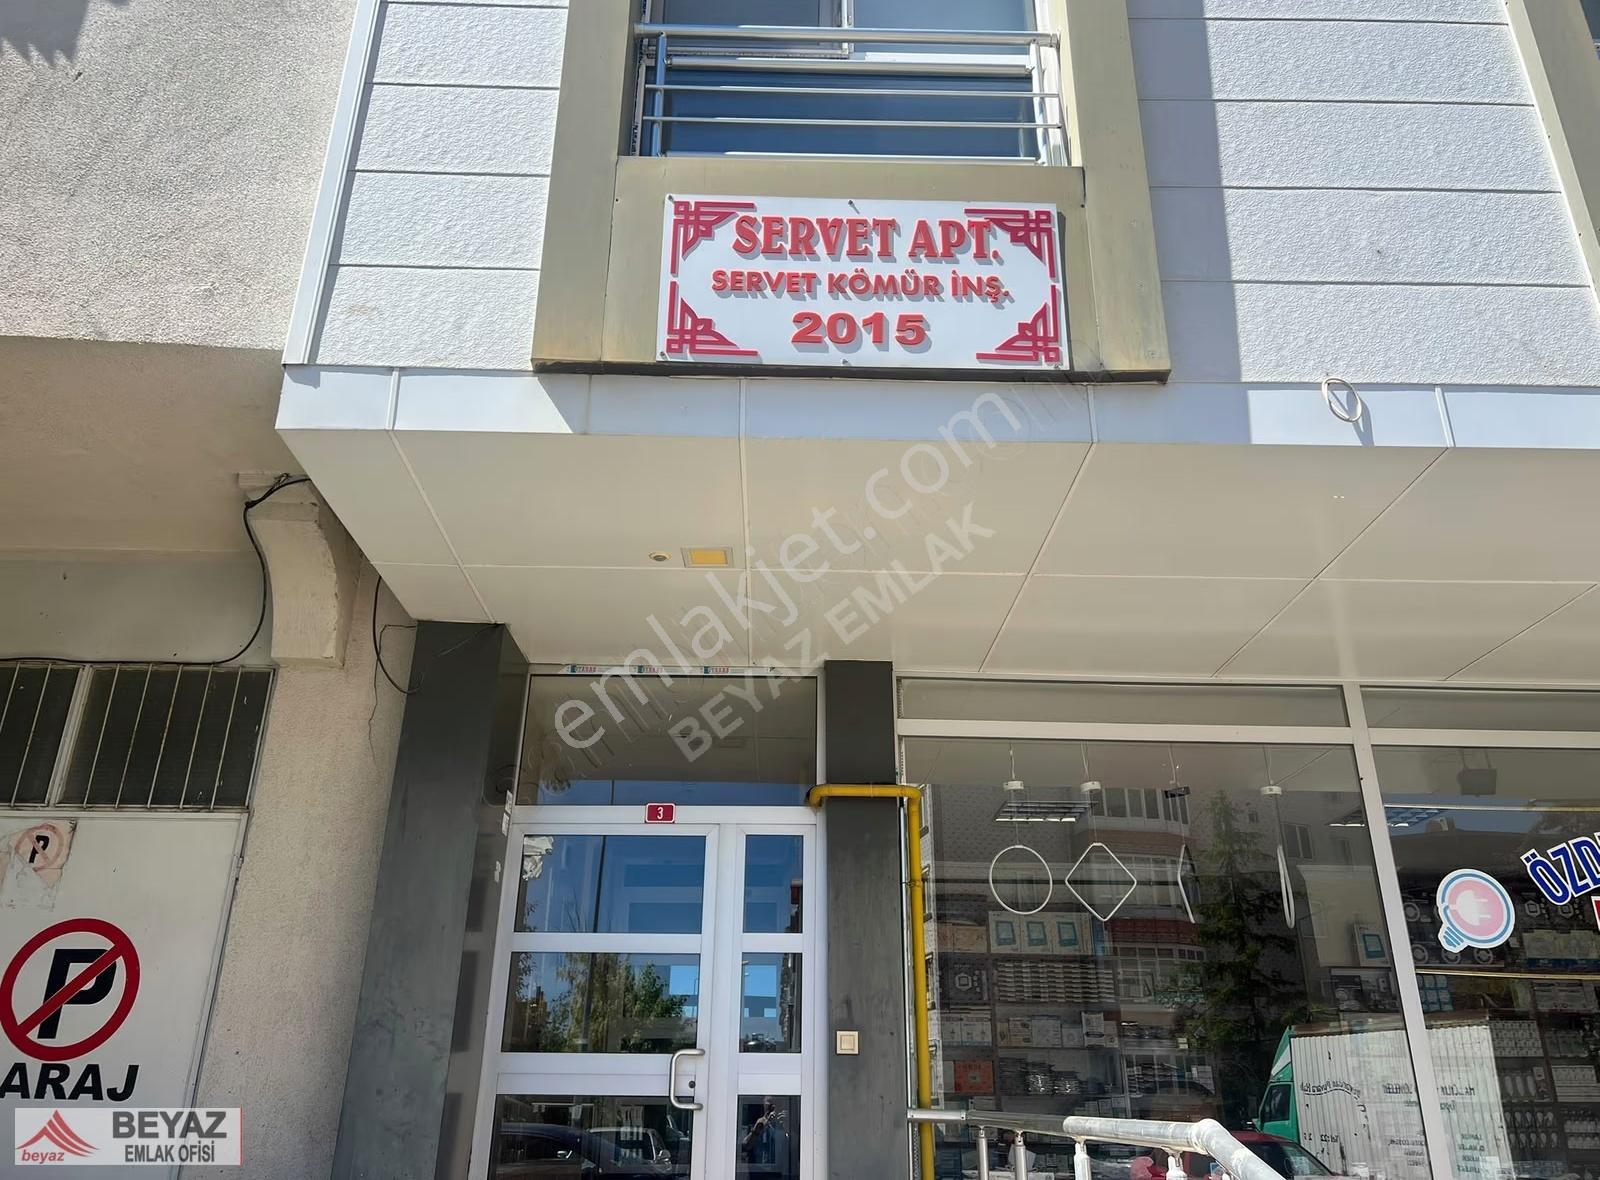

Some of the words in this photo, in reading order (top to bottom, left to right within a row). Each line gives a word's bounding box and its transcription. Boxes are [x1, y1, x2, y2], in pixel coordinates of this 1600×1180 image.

[731, 214, 898, 257] SERVET
[907, 218, 1001, 260] APT.
[711, 268, 817, 294] SERVET
[827, 267, 940, 297] KÖMÜR
[950, 268, 1010, 302] İNŞ.
[791, 310, 926, 346] 2015
[656, 806, 664, 820] 3
[1519, 832, 1600, 906] ÖZD
[0, 1062, 140, 1102] ARAJ
